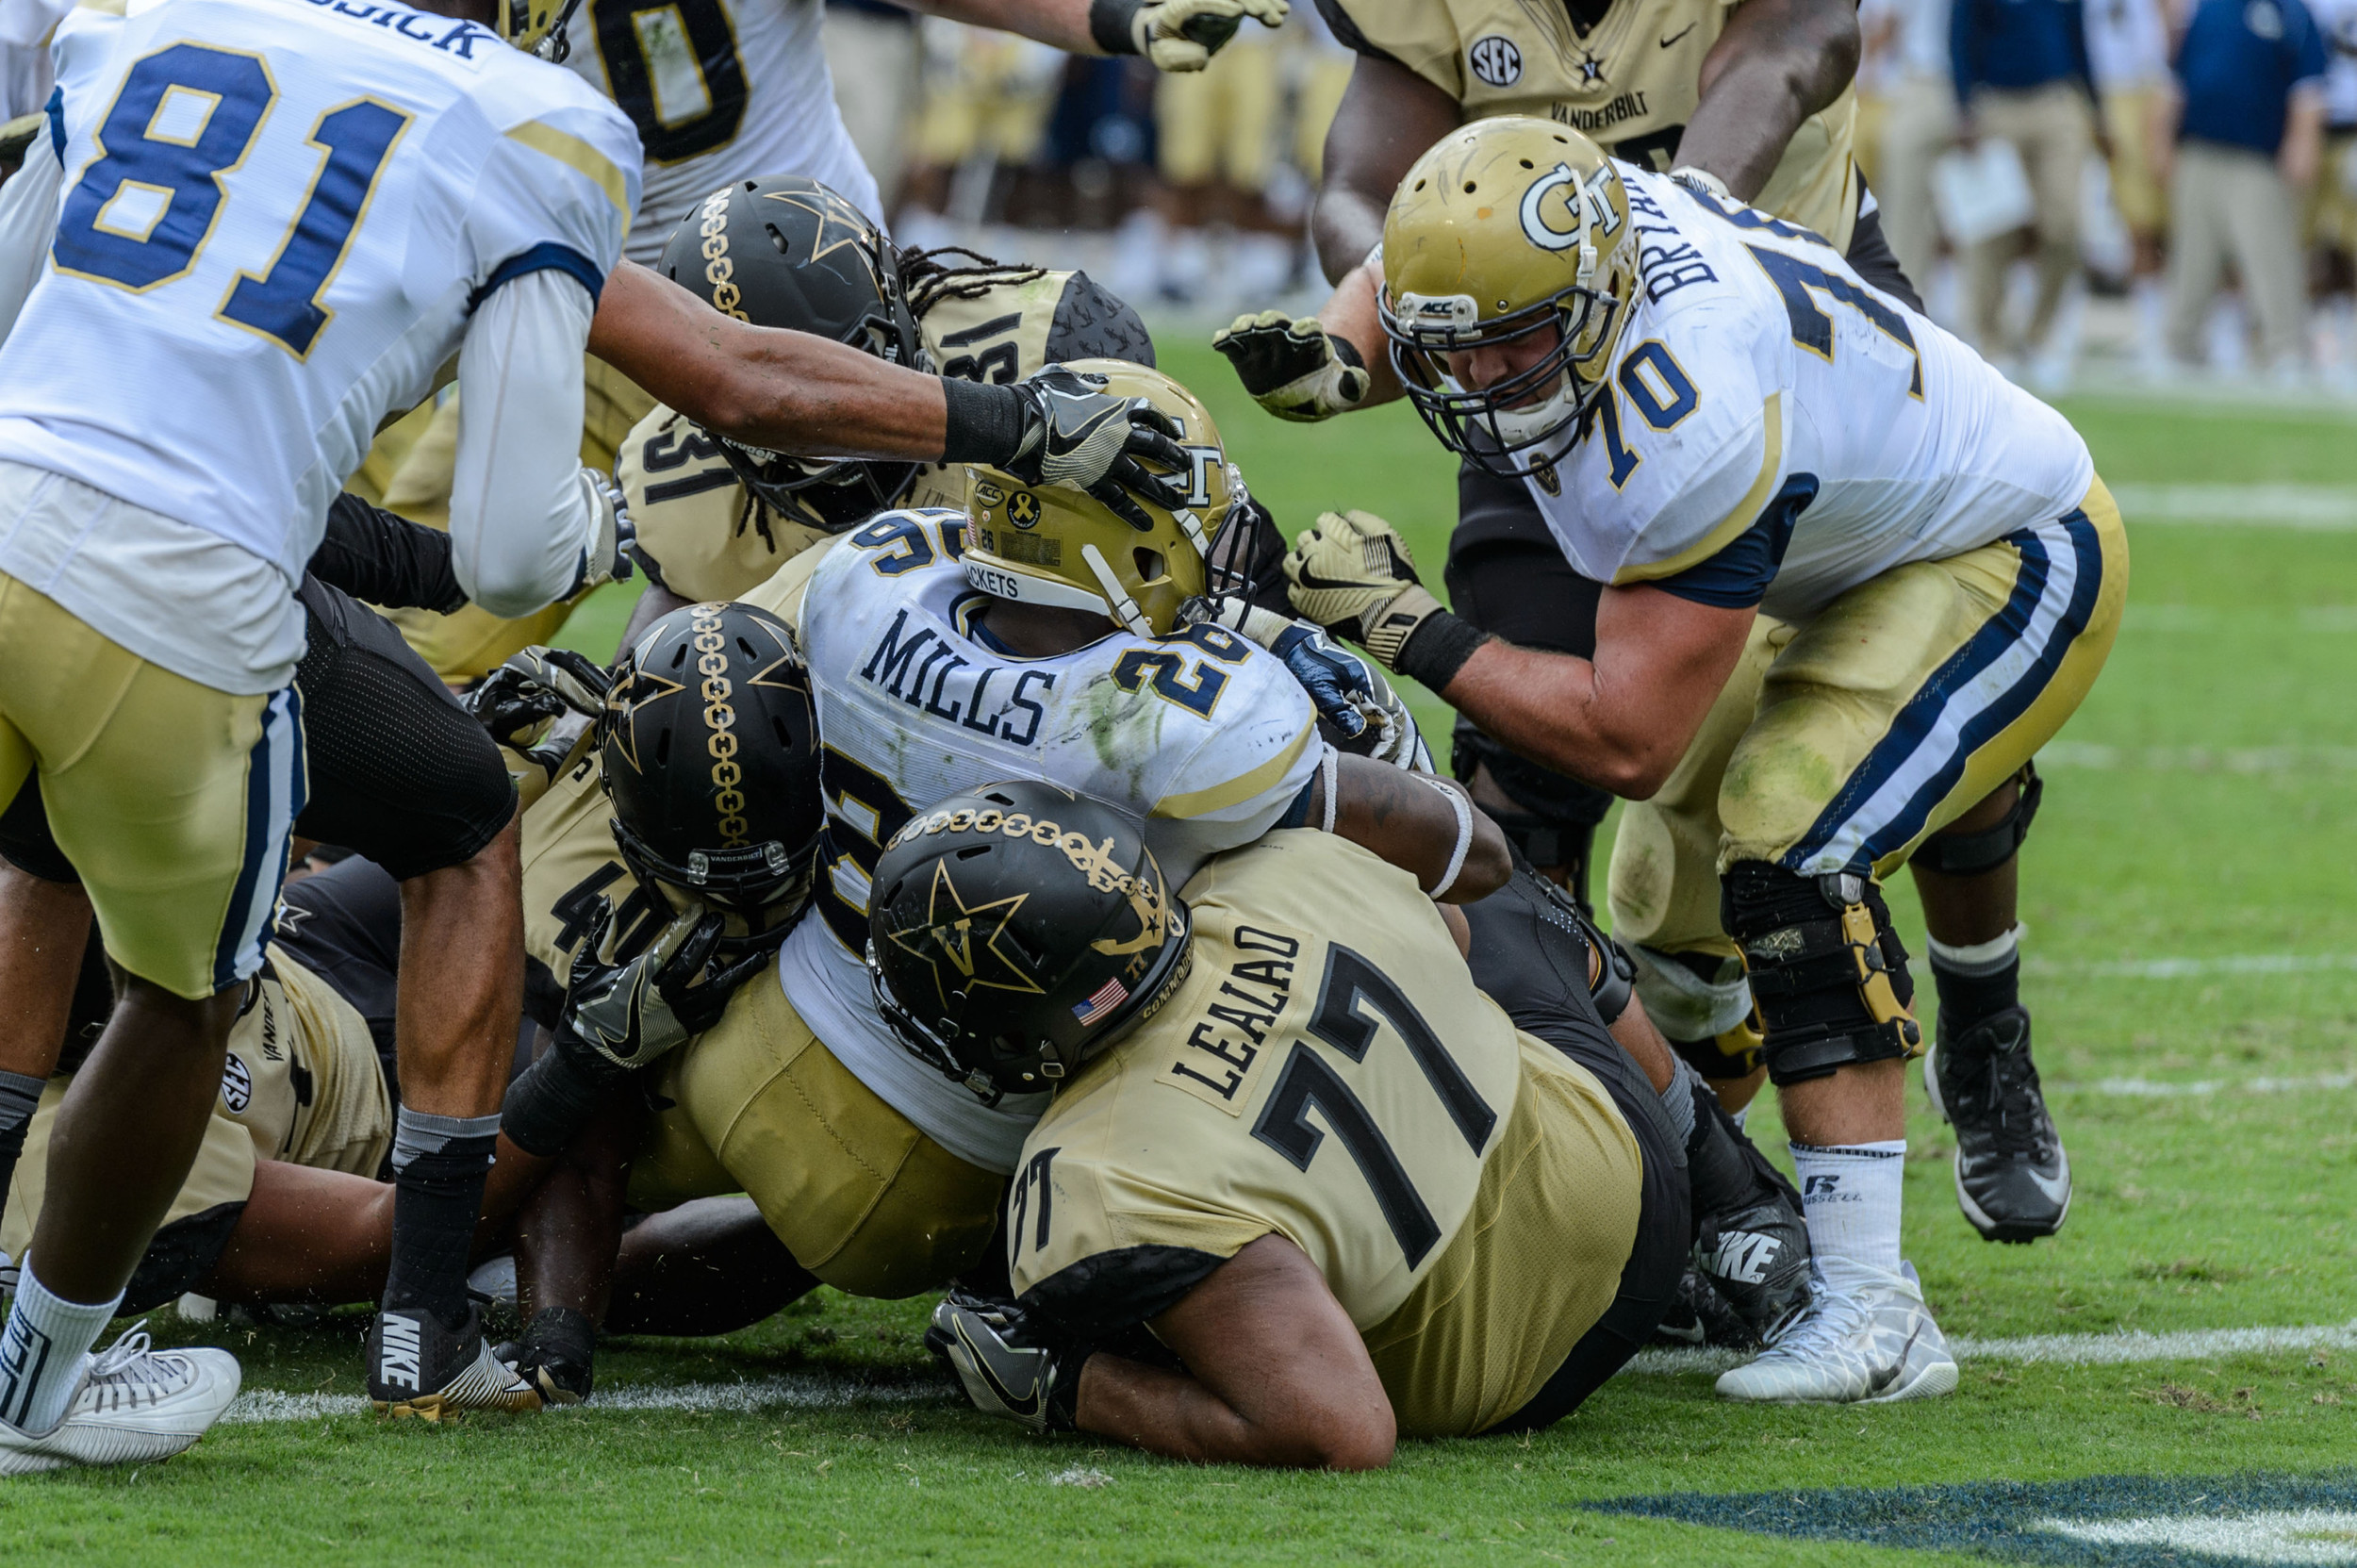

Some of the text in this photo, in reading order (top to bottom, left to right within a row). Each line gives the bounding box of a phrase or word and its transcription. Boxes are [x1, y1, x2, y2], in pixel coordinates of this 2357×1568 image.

[1472, 38, 1521, 85] SEC
[1552, 91, 1649, 131] VANDERBILT
[49, 40, 417, 365] 81
[1417, 302, 1454, 314] ACC
[1581, 338, 1703, 497] 70
[978, 485, 1000, 501] ACC
[981, 528, 995, 553] 26
[859, 607, 1056, 748] MILLS
[710, 850, 760, 863] VANDERBILT
[930, 917, 975, 977] V
[1171, 923, 1301, 1102] LEALAO
[1248, 939, 1499, 1274] 77
[1011, 1146, 1063, 1275] 77
[380, 1312, 420, 1394] NIKE
